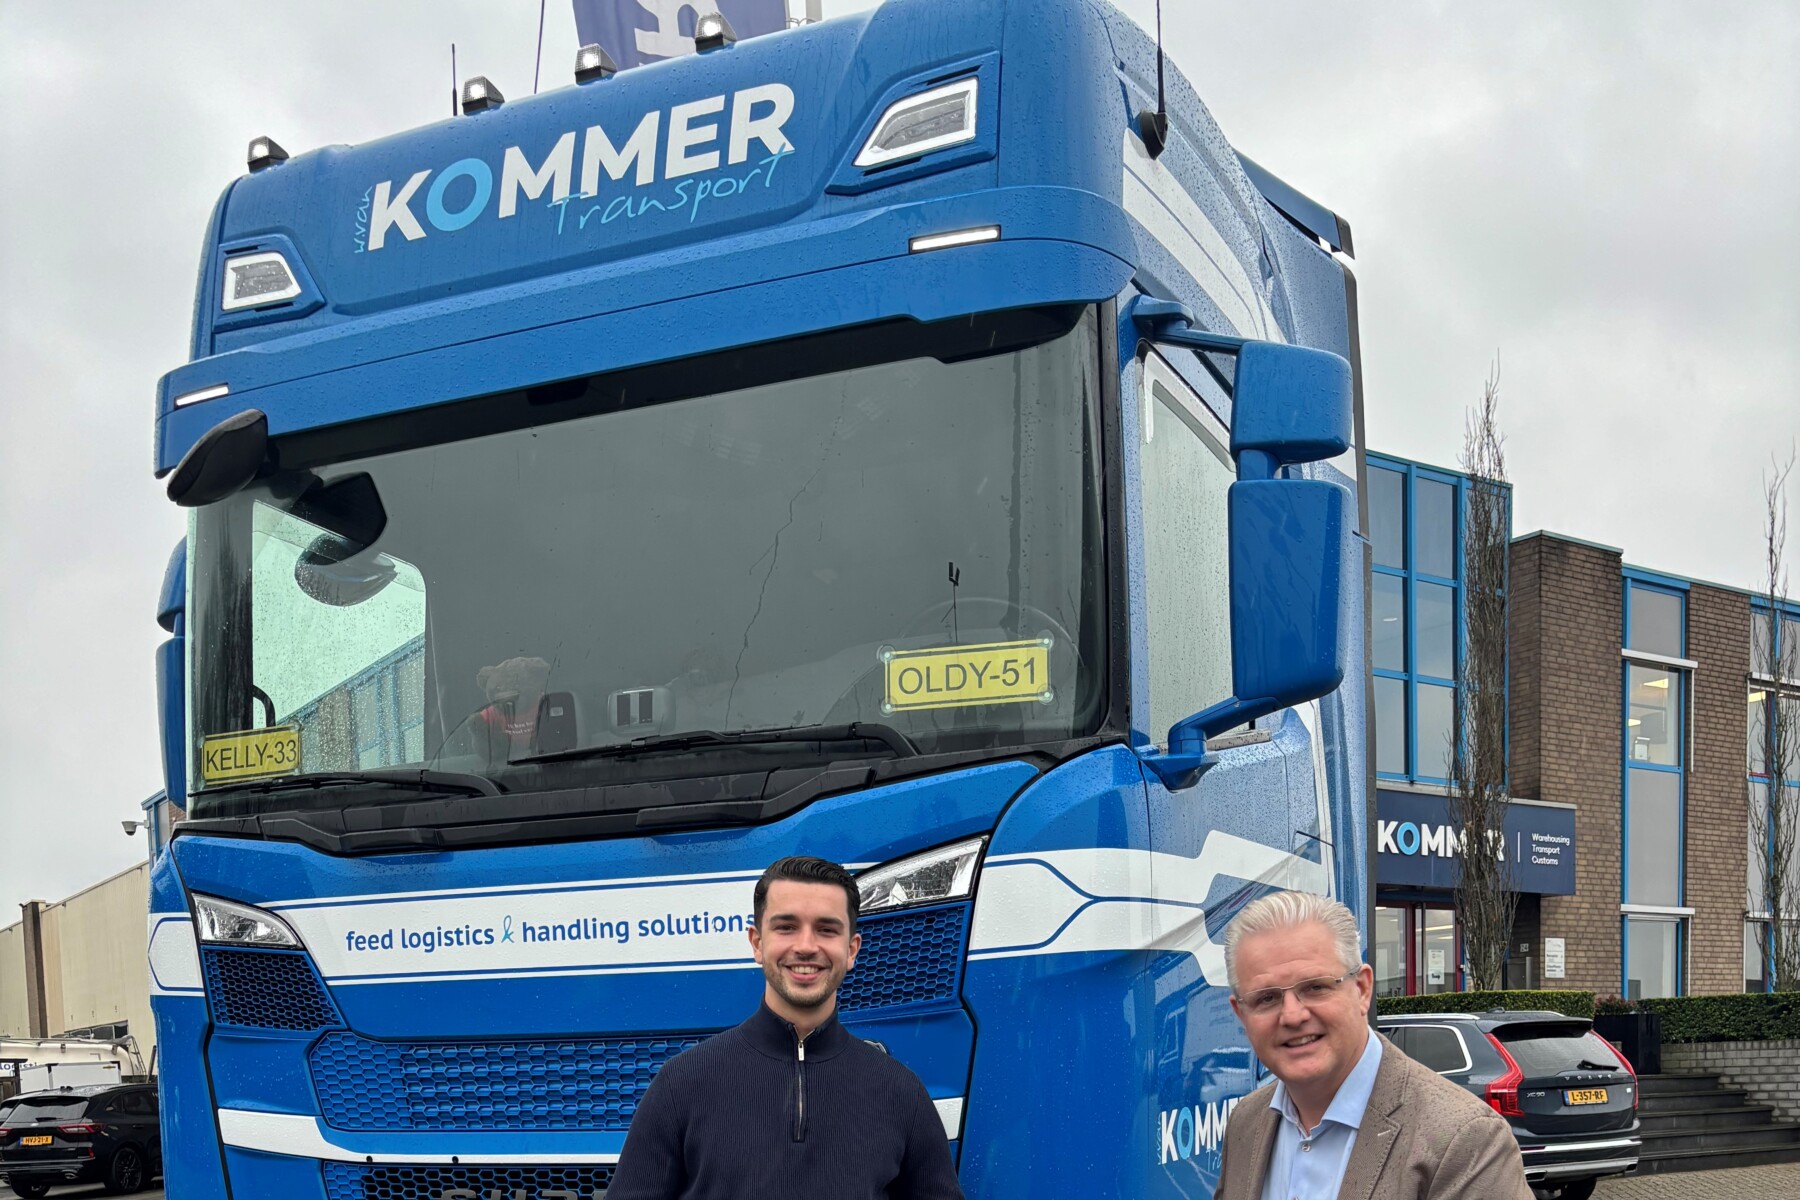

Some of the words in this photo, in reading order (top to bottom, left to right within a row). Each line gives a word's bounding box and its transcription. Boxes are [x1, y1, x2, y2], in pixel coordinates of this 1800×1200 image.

[368, 83, 795, 251] KOMMER
[547, 142, 795, 236] Transport
[898, 657, 1036, 695] OLDY-51
[206, 739, 297, 773] KELLY-33
[1531, 833, 1570, 846] Warehousing
[1531, 844, 1561, 855] Transport
[1531, 856, 1559, 866] Customs
[346, 929, 394, 951] feed
[401, 924, 494, 953] logistics
[522, 916, 629, 944] handling
[1571, 1090, 1605, 1102] L-357-RF
